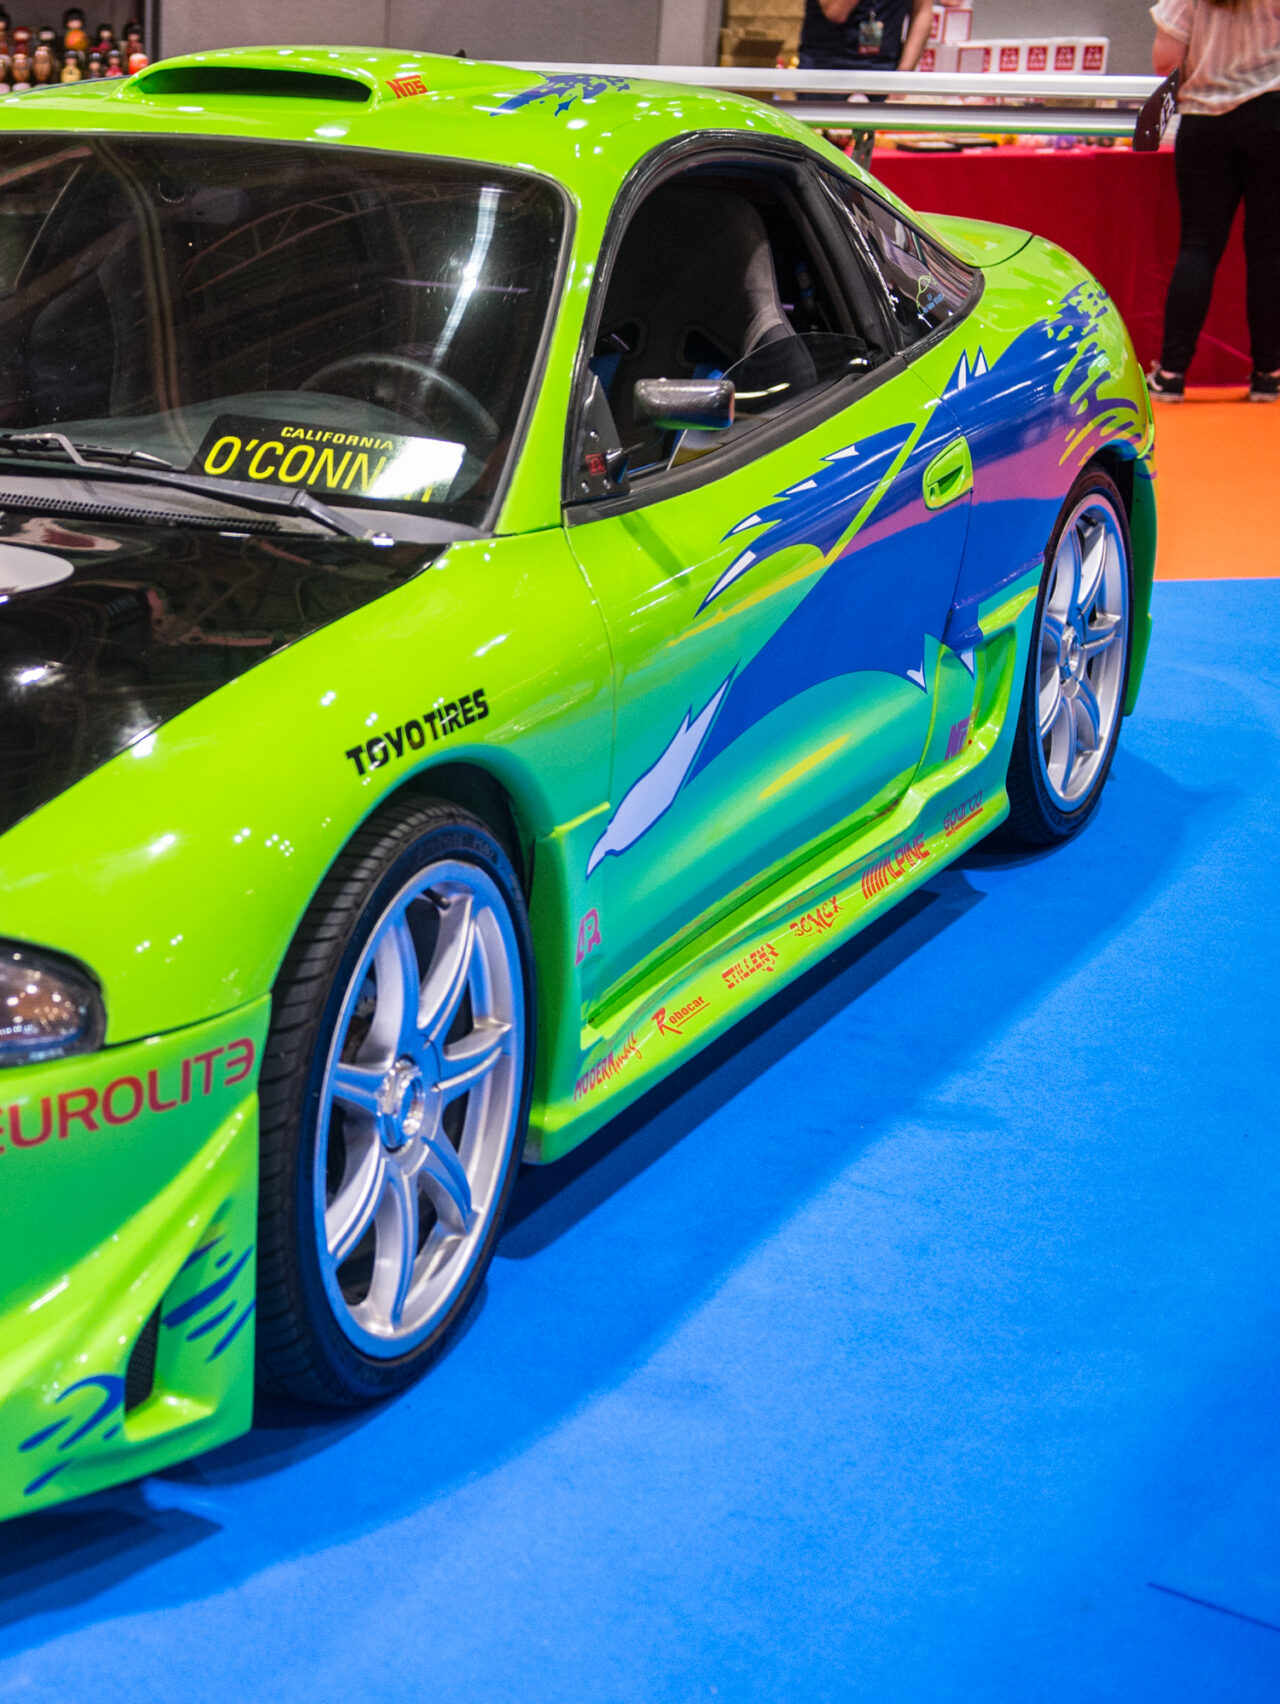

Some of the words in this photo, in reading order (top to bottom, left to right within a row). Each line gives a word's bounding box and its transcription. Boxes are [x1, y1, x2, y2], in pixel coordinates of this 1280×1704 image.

[385, 75, 428, 99] NOS
[280, 426, 394, 450] CALIFORNIA
[204, 436, 433, 503] O'CONN
[345, 719, 425, 776] TOYO
[423, 688, 490, 741] TIRES
[651, 995, 706, 1036] Robocar
